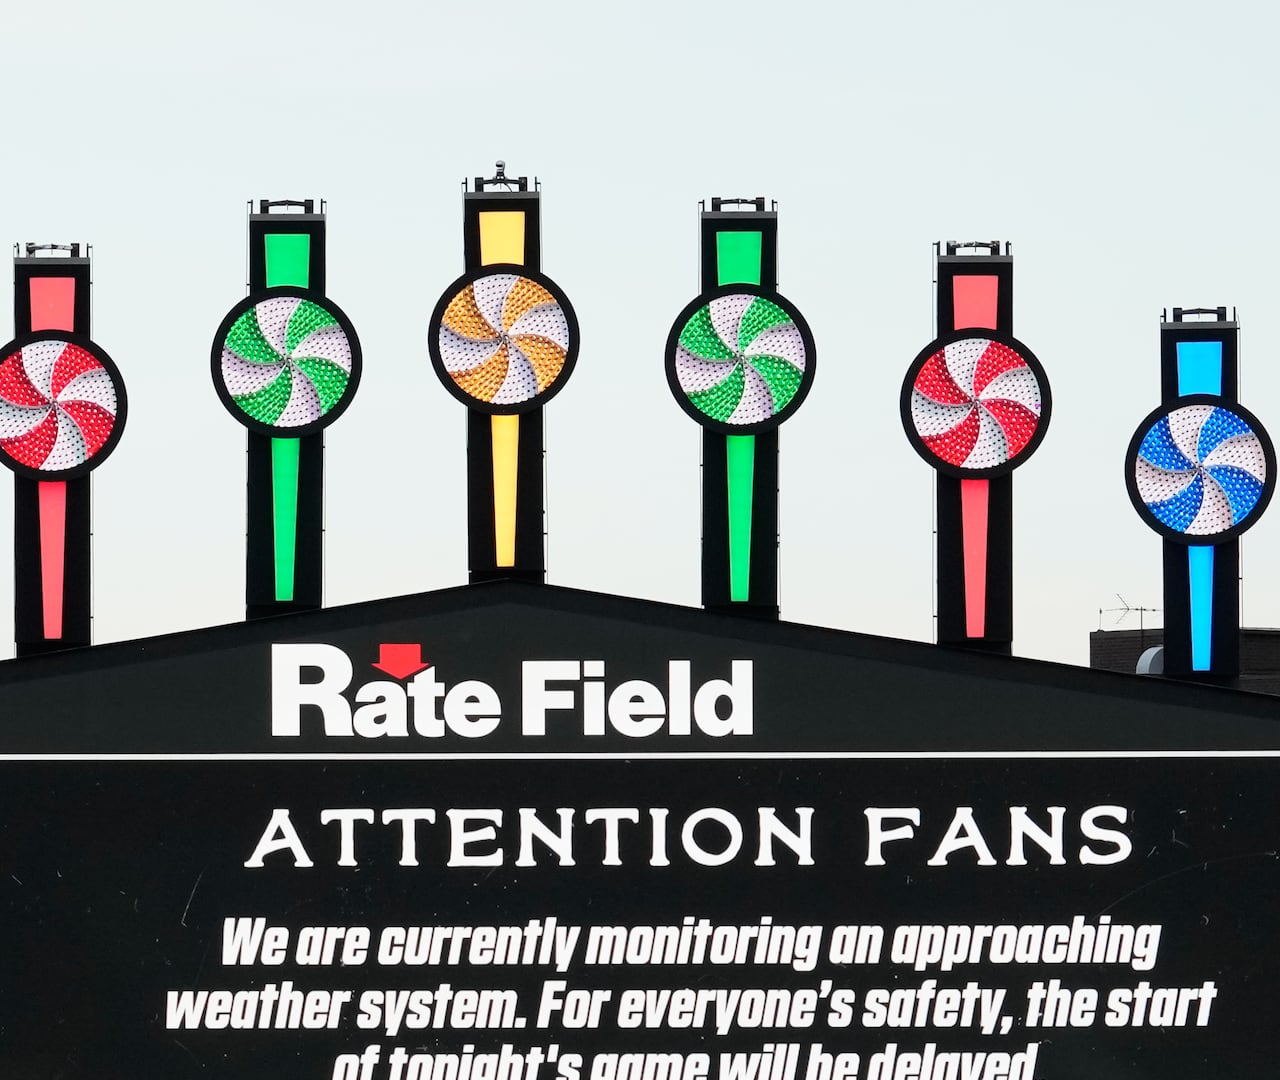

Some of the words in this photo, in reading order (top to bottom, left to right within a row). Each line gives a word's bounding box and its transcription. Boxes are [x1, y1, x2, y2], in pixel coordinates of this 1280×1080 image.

[271, 643, 502, 739] Rate
[521, 659, 754, 738] Field
[243, 806, 815, 868] ATTENTION
[863, 805, 1133, 866] FANS
[222, 917, 290, 966] We
[295, 926, 371, 966] are
[377, 916, 582, 973] currently
[584, 915, 823, 973] monitoring
[828, 925, 885, 964] an
[890, 915, 1162, 972] approaching
[165, 980, 352, 1030] weather
[356, 983, 527, 1037] system.
[536, 980, 612, 1029] For
[861, 979, 1014, 1035] safety,
[1025, 978, 1099, 1028] the
[1104, 981, 1218, 1027] start
